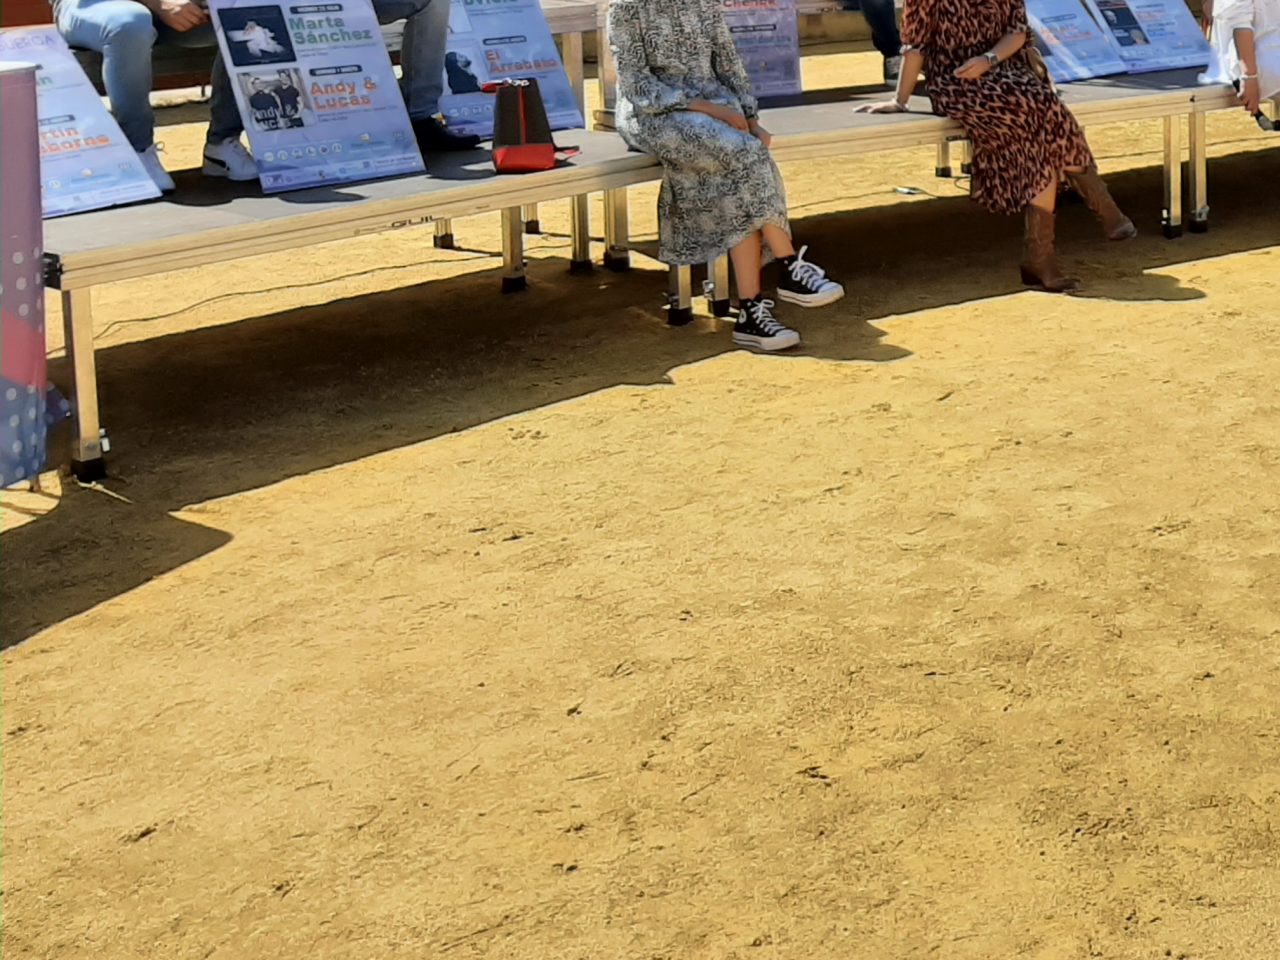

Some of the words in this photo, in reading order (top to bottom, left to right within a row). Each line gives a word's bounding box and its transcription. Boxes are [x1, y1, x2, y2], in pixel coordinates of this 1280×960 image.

[289, 16, 345, 31] Marta
[293, 28, 374, 45] Sánchez
[485, 49, 500, 61] El
[311, 79, 356, 96] Andy
[364, 77, 377, 91] &
[314, 94, 372, 110] Lucas
